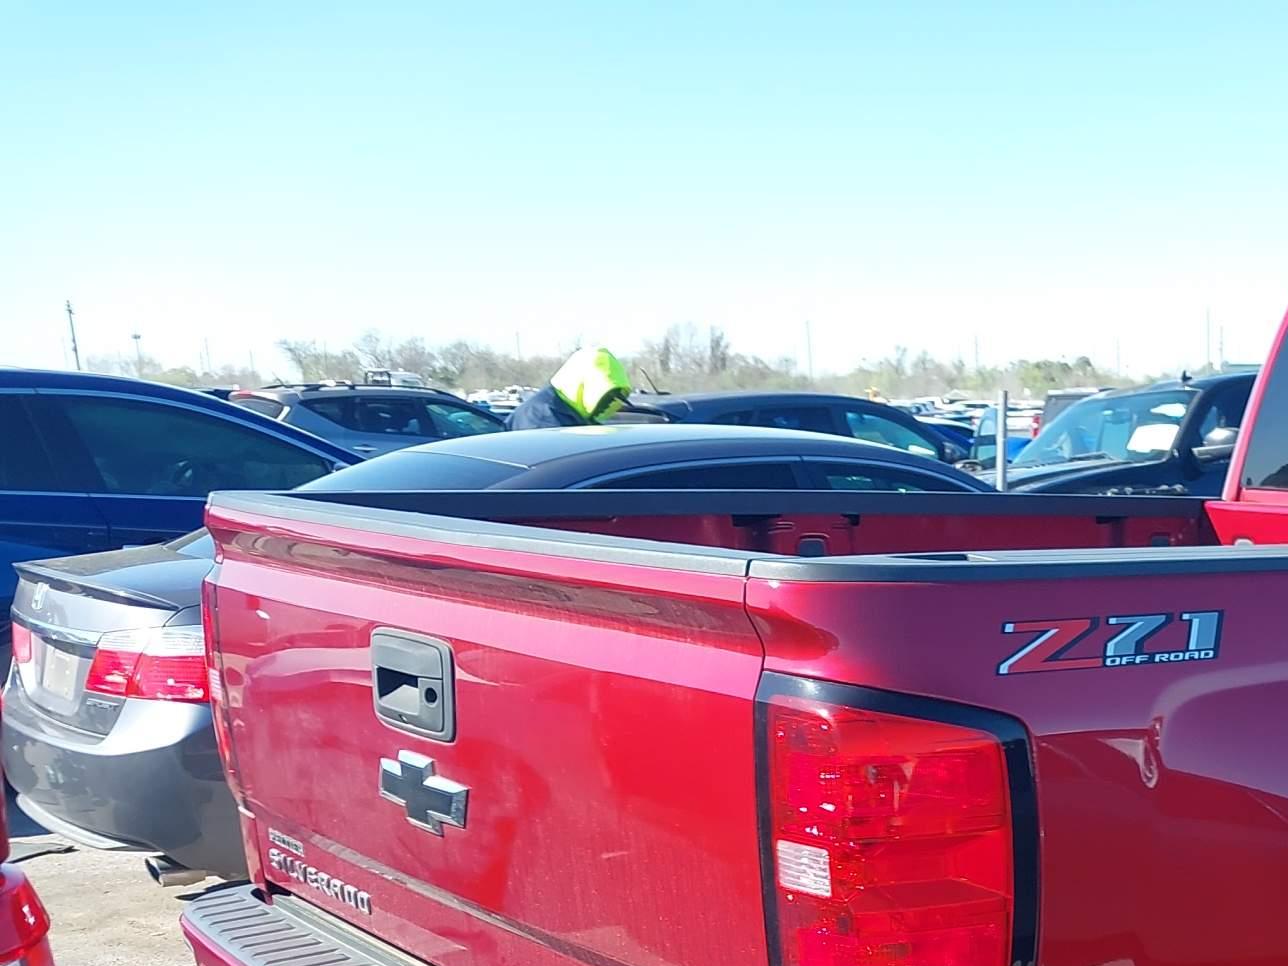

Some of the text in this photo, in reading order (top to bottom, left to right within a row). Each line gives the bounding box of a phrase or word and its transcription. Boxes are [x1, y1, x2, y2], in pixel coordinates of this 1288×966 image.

[995, 610, 1224, 676] Z71
[1104, 649, 1214, 667] OFF ROAD
[268, 848, 372, 915] SILVERADO
